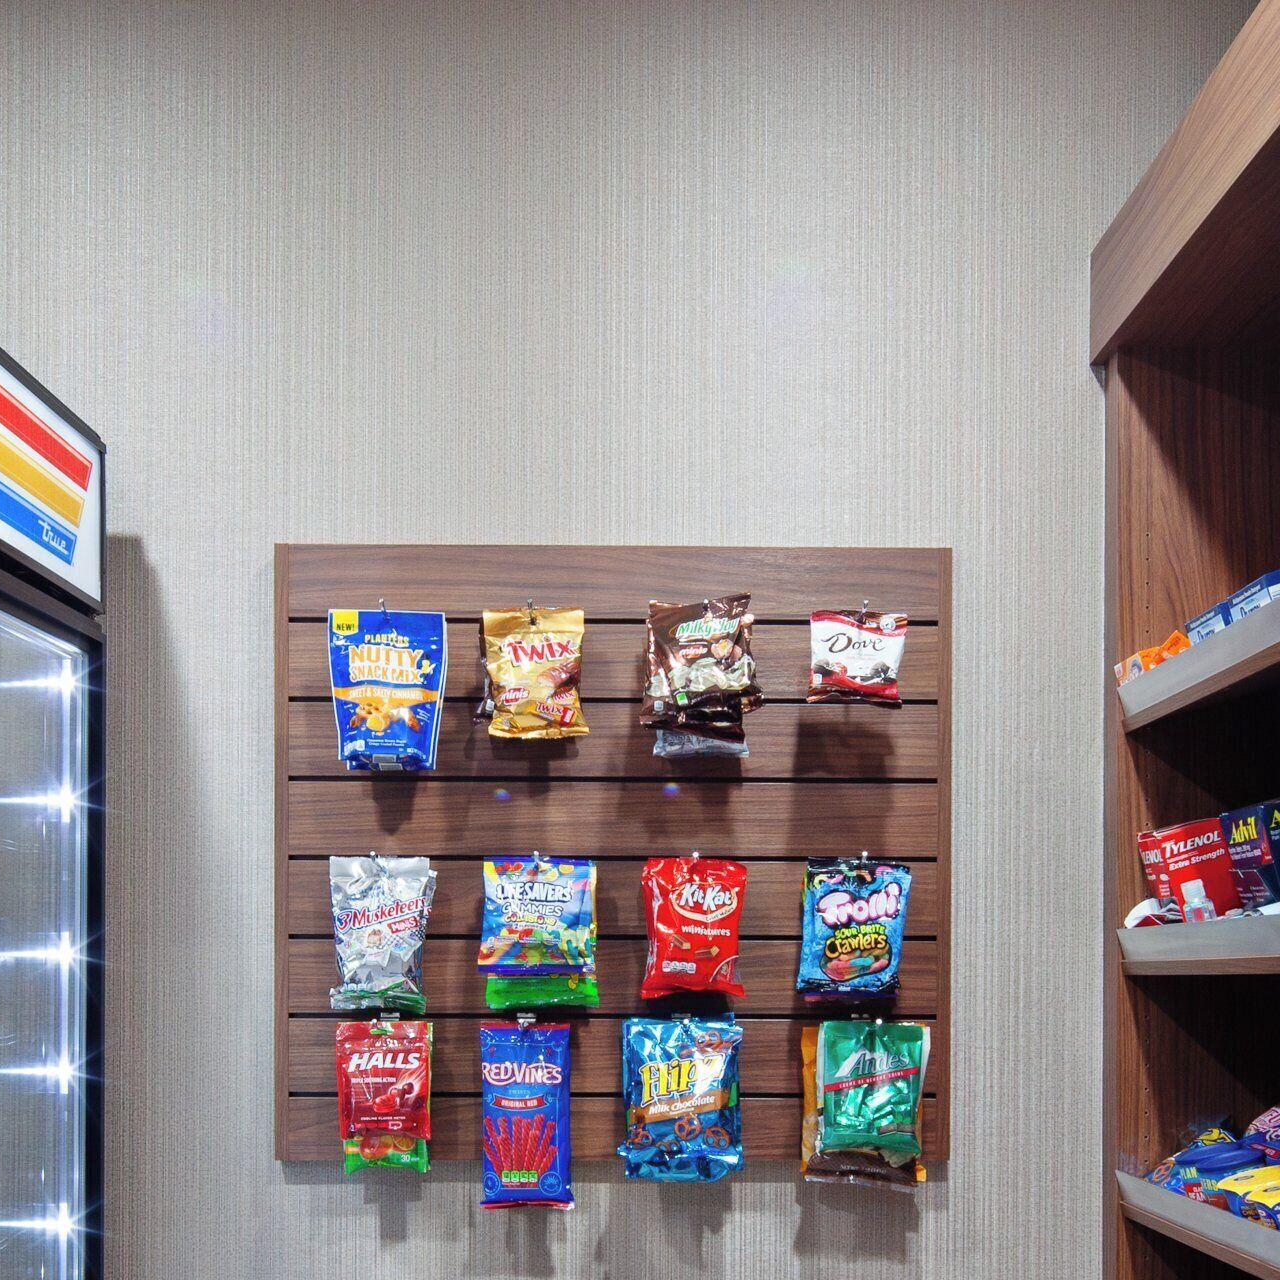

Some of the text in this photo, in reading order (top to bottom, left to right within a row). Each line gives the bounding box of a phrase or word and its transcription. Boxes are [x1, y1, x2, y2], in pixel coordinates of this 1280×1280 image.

[350, 645, 423, 667] NUTTY
[351, 665, 388, 682] SNACK
[1229, 816, 1258, 845] Advil
[1161, 830, 1221, 859] TYLENOL
[1169, 857, 1190, 871] Extra
[1191, 848, 1225, 864] Strength
[502, 902, 563, 917] GUMMIES
[818, 882, 900, 924] Trolli
[336, 910, 352, 931] 3
[681, 924, 731, 937] miniatures
[835, 922, 887, 940] SOUR BRITE
[347, 1052, 421, 1073] HALLS
[848, 1051, 911, 1078] Andes
